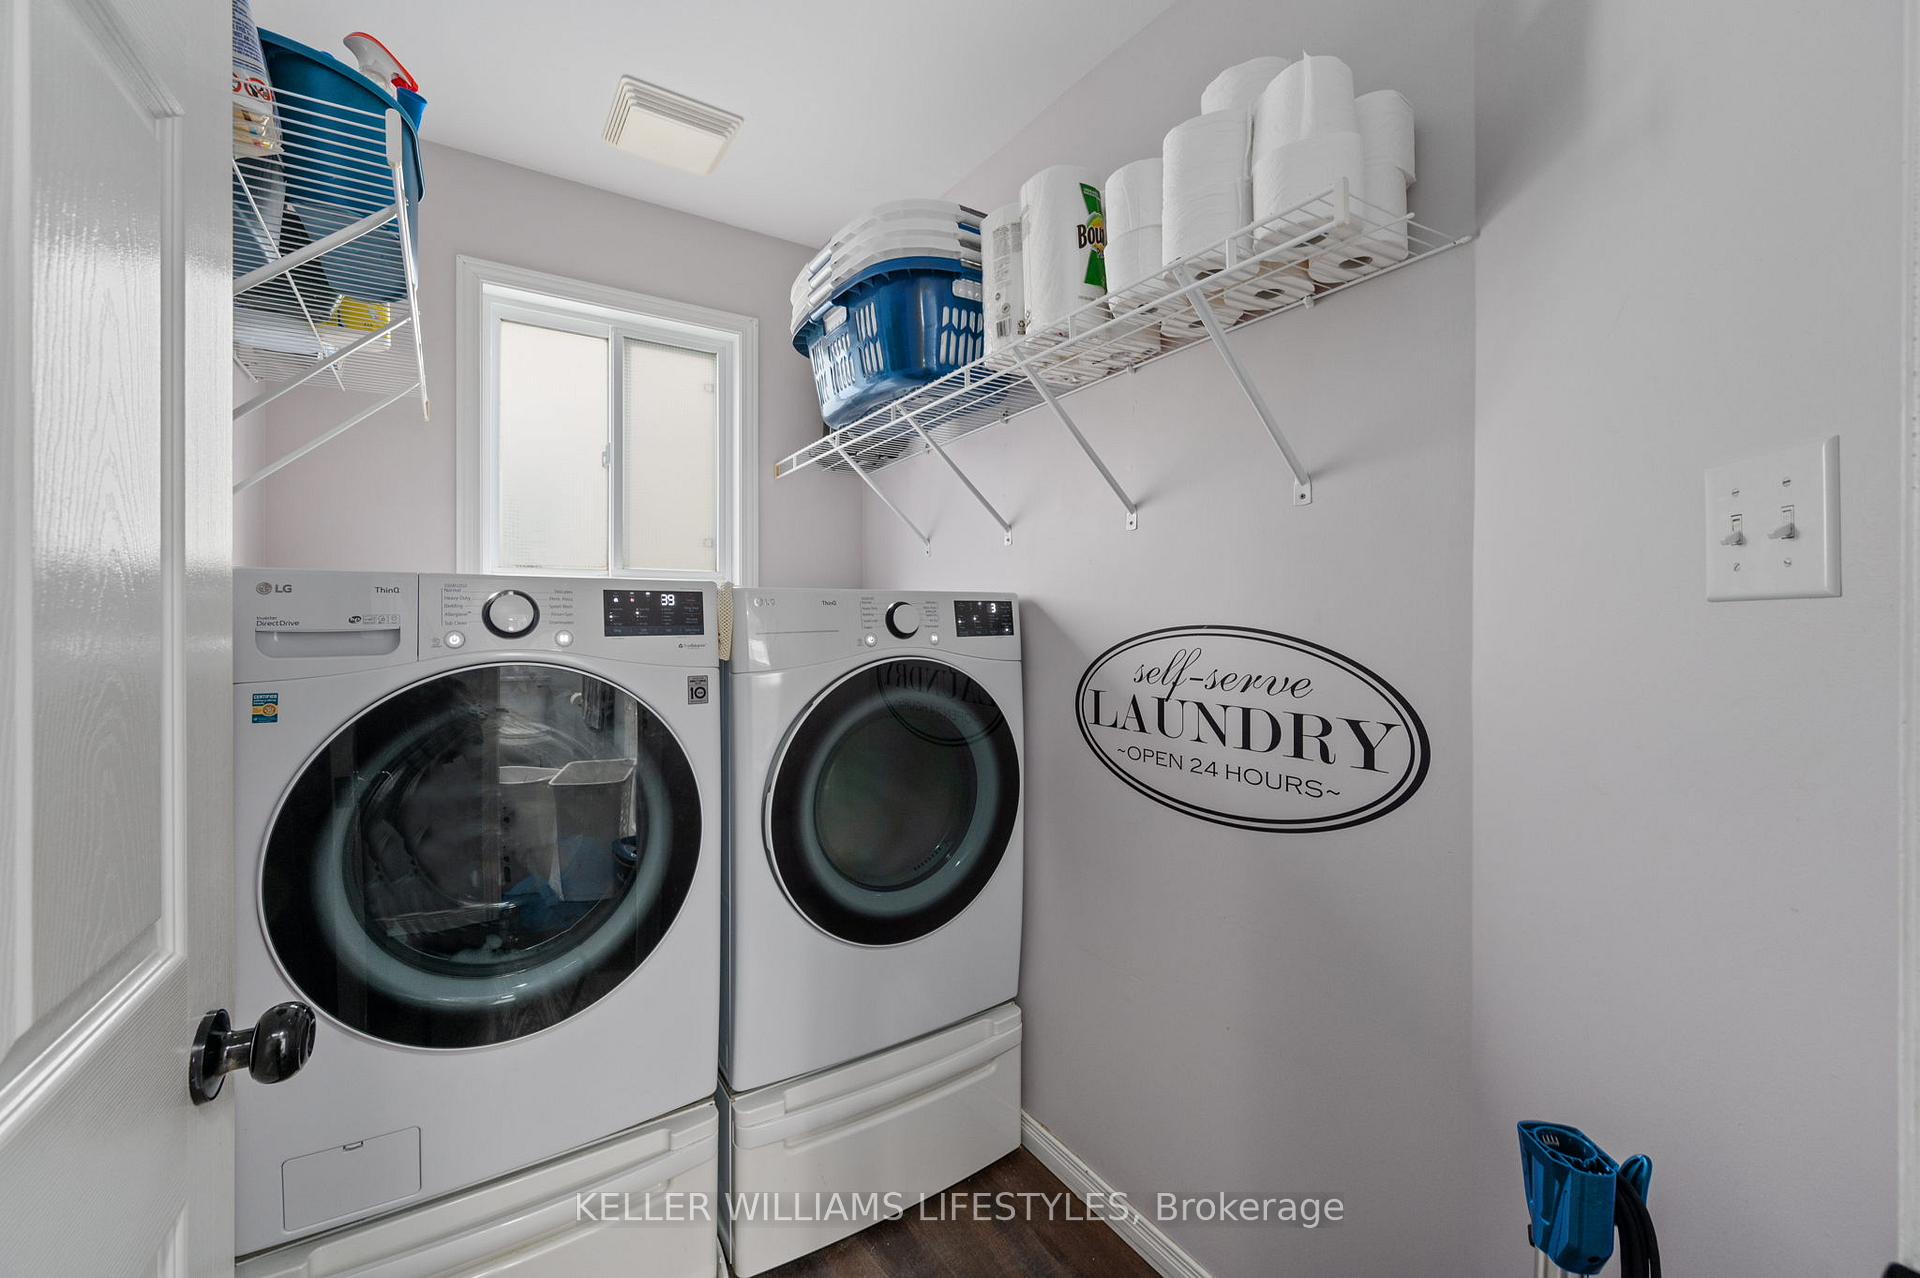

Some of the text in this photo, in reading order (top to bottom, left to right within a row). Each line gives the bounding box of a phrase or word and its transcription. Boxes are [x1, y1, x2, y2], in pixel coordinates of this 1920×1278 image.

[274, 584, 293, 594] LG
[375, 586, 401, 594] ThinQ
[660, 593, 675, 606] 39
[990, 603, 997, 613] 3
[1132, 647, 1314, 702] self-serve
[1088, 688, 1401, 775] LAUNDRY
[1189, 757, 1220, 777] 24
